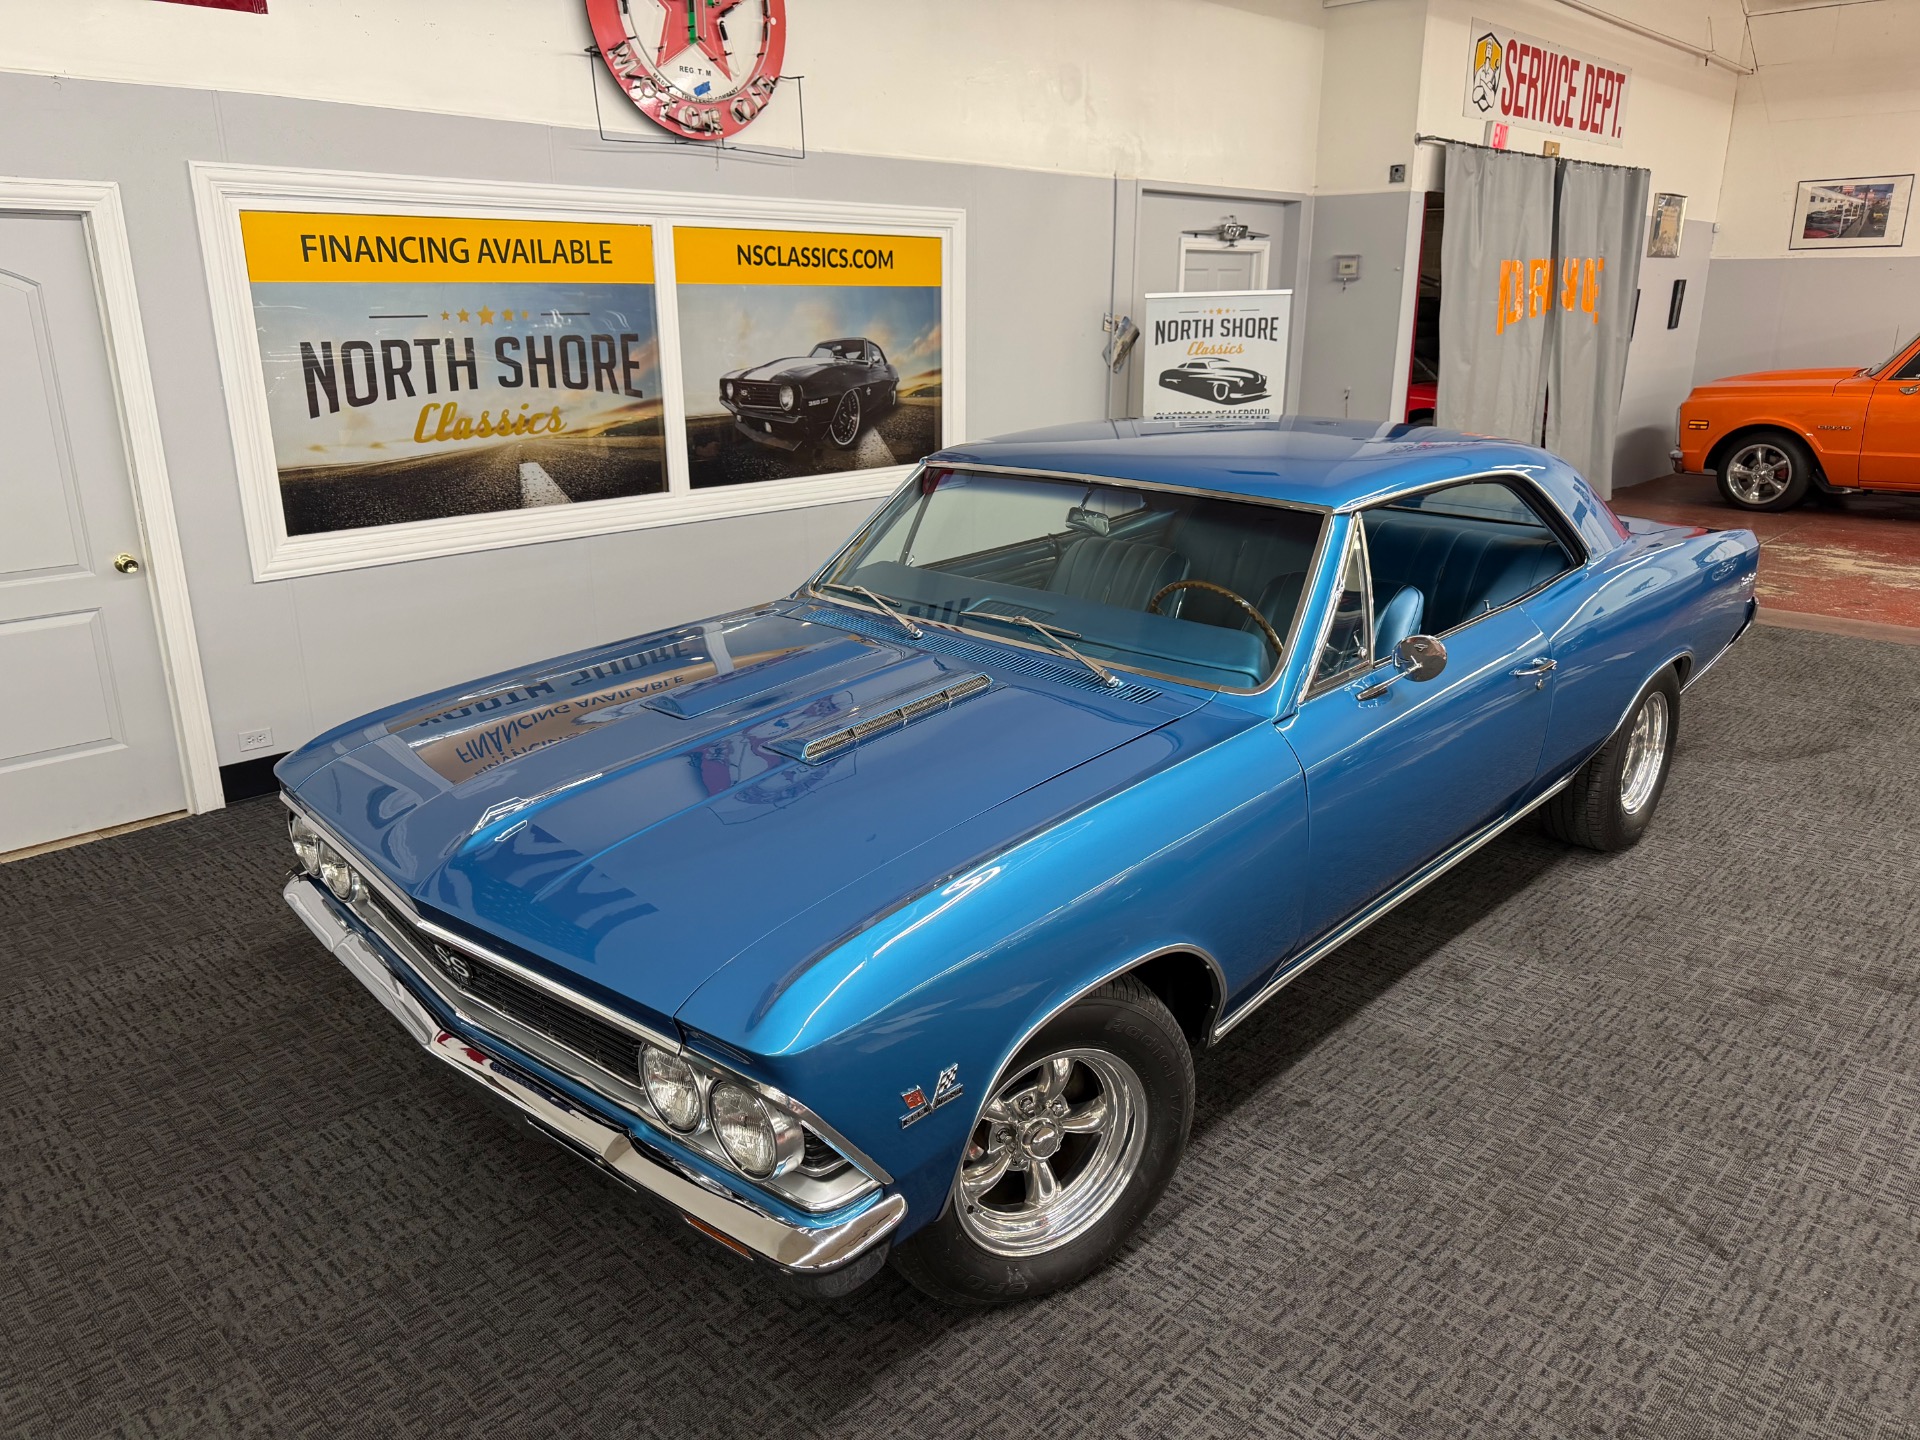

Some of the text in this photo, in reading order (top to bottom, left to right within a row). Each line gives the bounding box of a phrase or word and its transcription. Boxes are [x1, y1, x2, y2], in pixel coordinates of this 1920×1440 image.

[1501, 38, 1626, 139] SERVICE DEPT.
[300, 233, 613, 264] FINANCING AVAILABLE
[736, 244, 894, 269] NSCLASSICS.COM
[1154, 316, 1279, 345] NORTH SHORE
[1186, 341, 1245, 356] Classics
[300, 333, 643, 419] NORTH SHORE
[413, 401, 568, 444] Classics
[434, 943, 470, 978] SS
